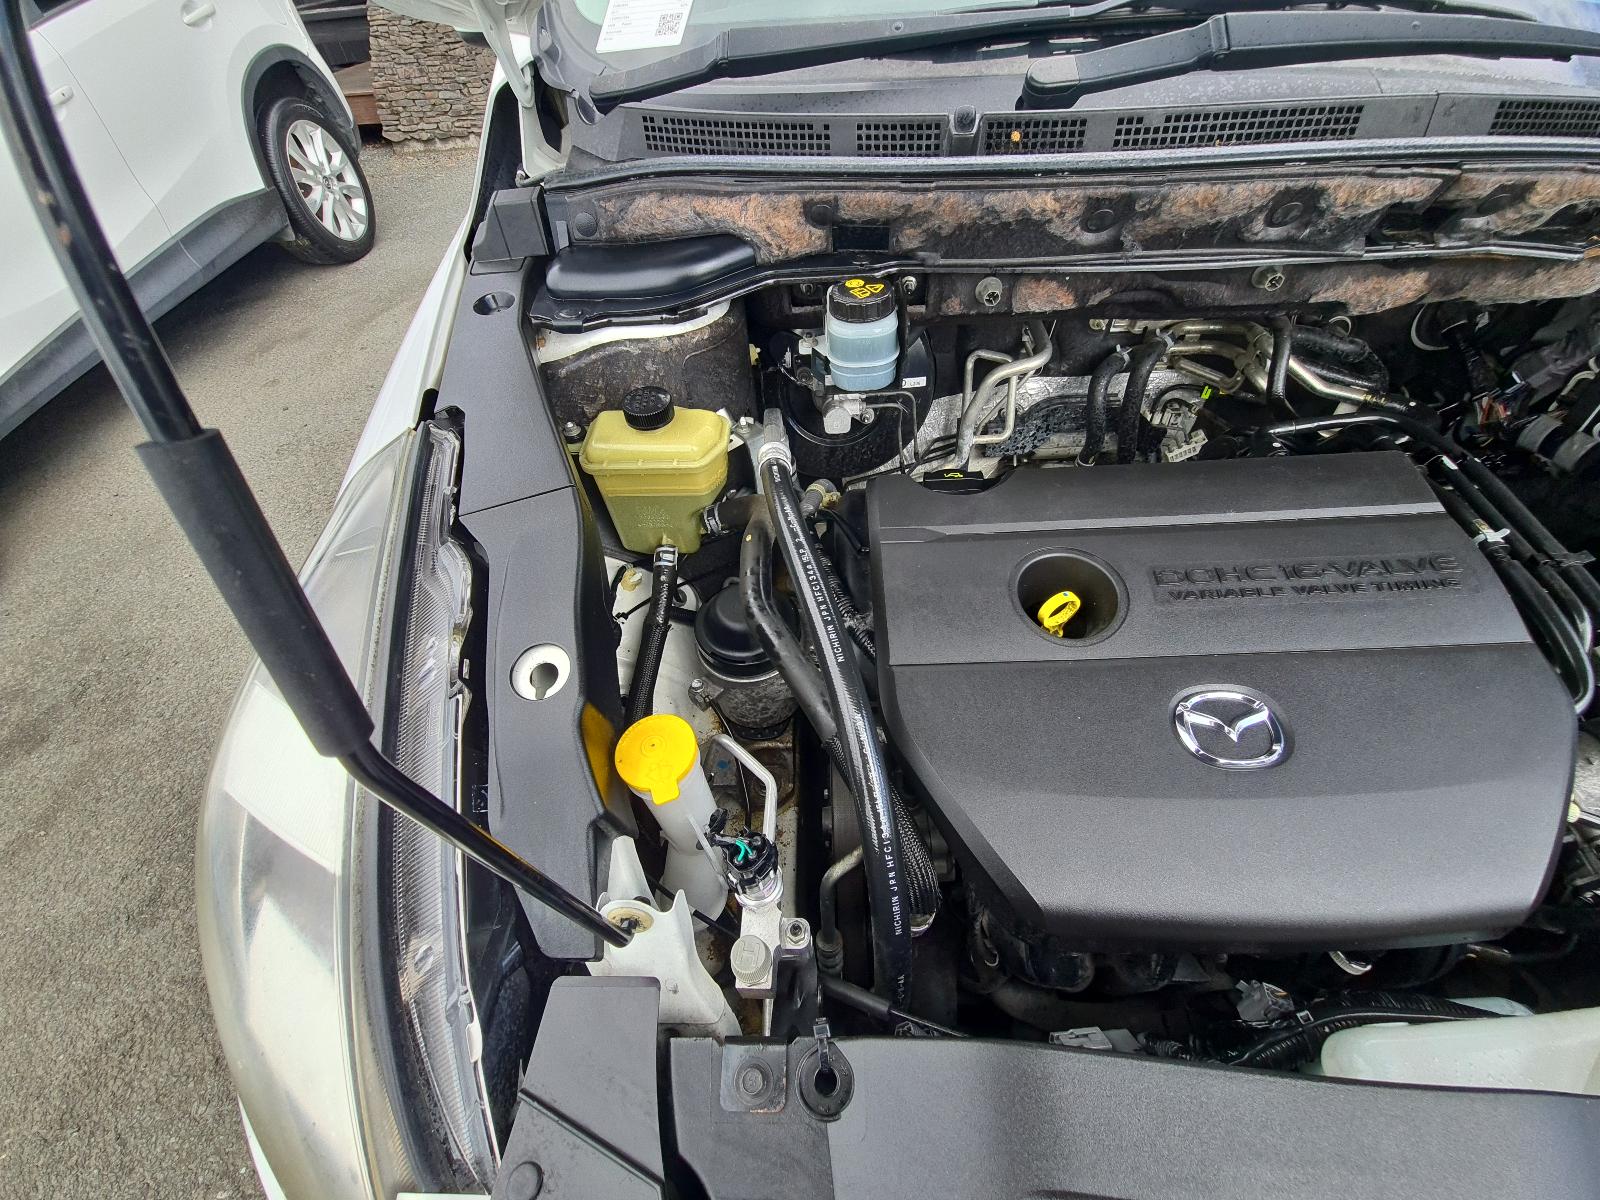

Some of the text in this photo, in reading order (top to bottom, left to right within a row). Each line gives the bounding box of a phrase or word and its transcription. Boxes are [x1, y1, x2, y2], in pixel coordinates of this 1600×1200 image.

[1168, 586, 1288, 600] VARIABLE
[1290, 582, 1369, 596] VALVE
[826, 624, 845, 662] NICHIRIN
[892, 895, 903, 936] NICHIRIN
